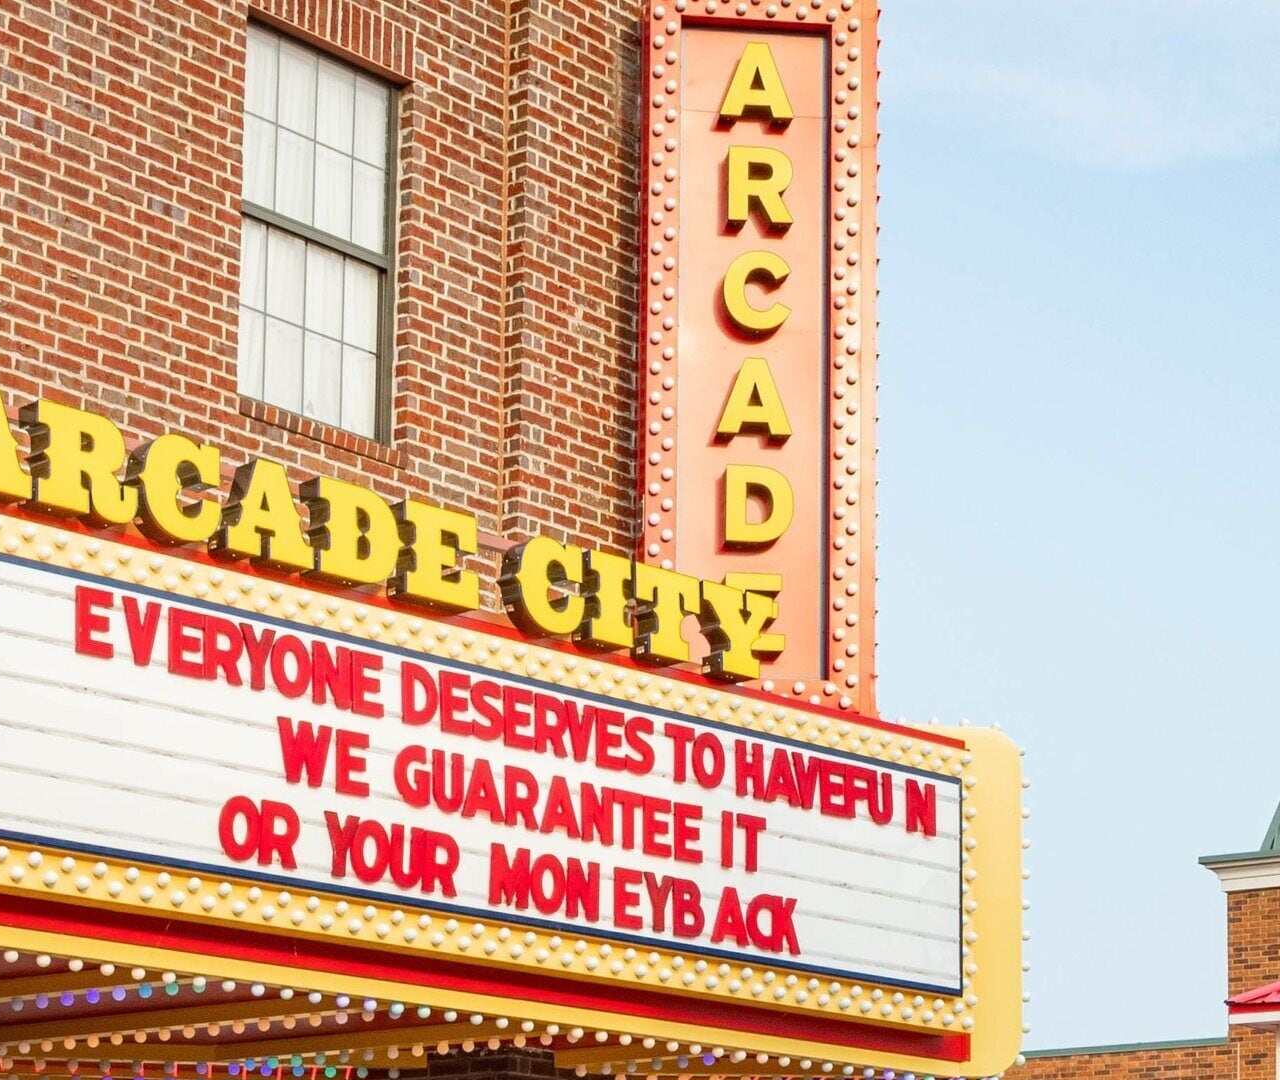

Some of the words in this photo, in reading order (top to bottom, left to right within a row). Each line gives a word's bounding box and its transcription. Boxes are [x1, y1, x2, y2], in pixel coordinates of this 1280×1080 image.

[504, 536, 778, 680] CITY
[76, 586, 385, 718] EVERYONE
[401, 661, 654, 776] DESERVES
[665, 722, 726, 789] TO
[219, 795, 300, 869] OR
[324, 810, 460, 897] YOUR
[277, 716, 370, 797] WE
[394, 744, 704, 864] GUARANTEE
[720, 810, 767, 873] IT
